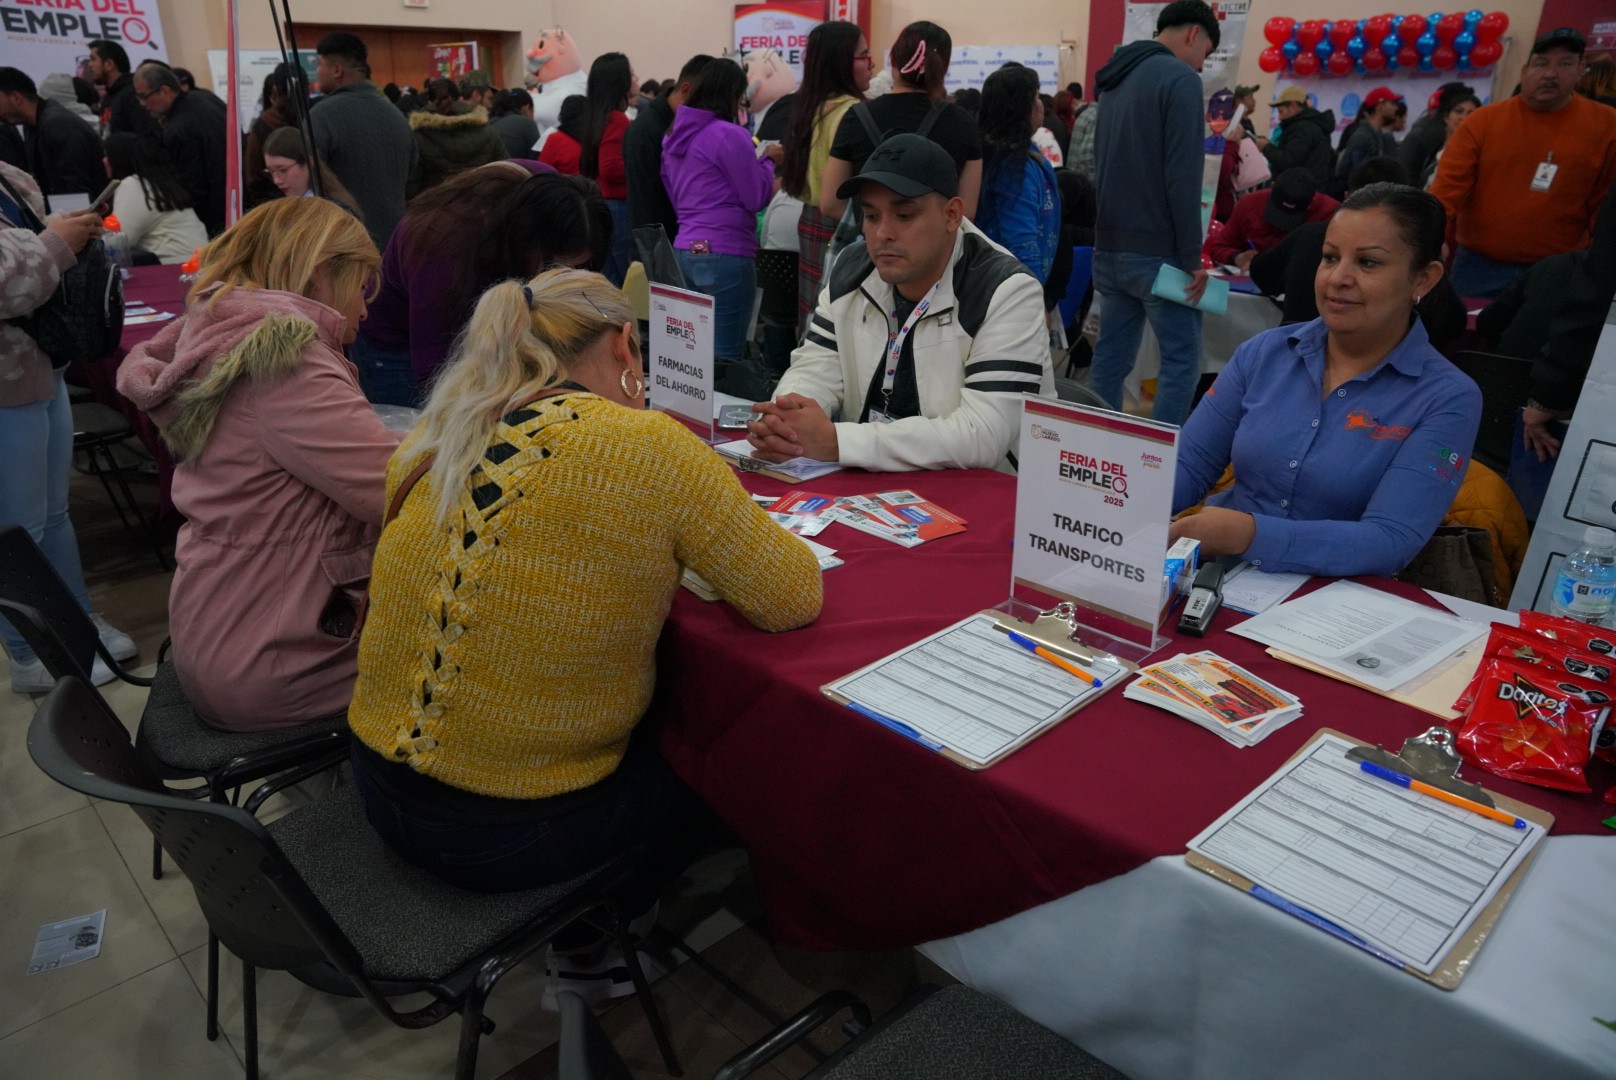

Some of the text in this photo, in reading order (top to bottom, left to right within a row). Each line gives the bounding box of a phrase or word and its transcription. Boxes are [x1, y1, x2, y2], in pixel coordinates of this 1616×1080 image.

[92, 0, 145, 16] DEL
[741, 34, 808, 48] FERIA DE
[666, 316, 695, 331] FERIA DEL
[658, 355, 704, 380] FARMACIAS
[656, 374, 707, 401] DEL AHORRO
[1042, 429, 1059, 438] NUEVO
[1042, 434, 1061, 443] LAREDO
[1059, 449, 1128, 478] FERIA DEL
[1141, 451, 1163, 463] Juntos
[1059, 462, 1128, 497] EMPLEO
[1103, 495, 1124, 508] 2025
[1053, 513, 1124, 547] TRAFICO
[1028, 533, 1146, 583] TRANSPORTES
[1498, 682, 1569, 716] Doritos
